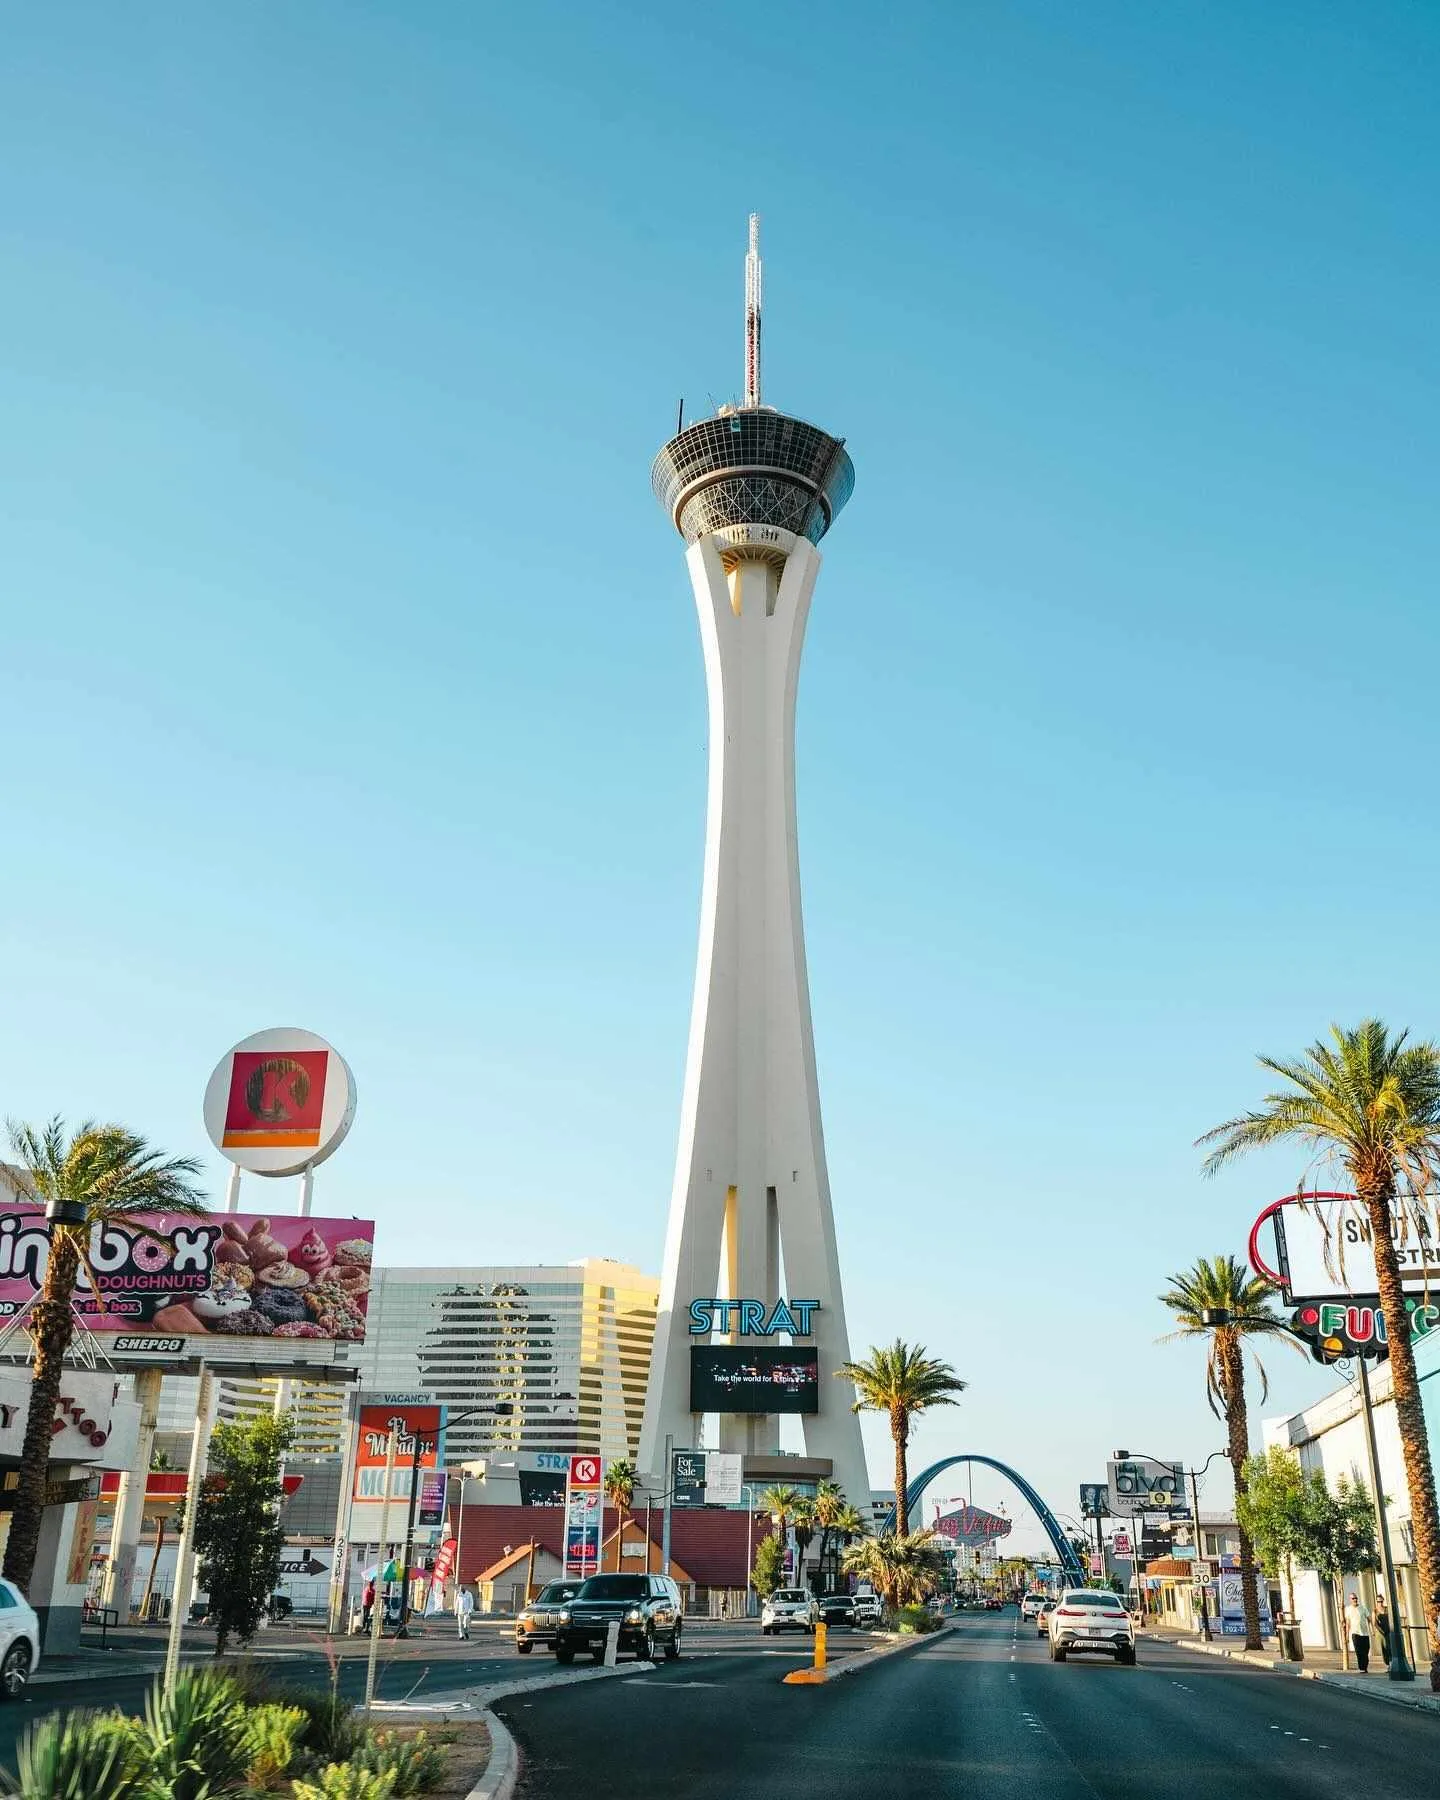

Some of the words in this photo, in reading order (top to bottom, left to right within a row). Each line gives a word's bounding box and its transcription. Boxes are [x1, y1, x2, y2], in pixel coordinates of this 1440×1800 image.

[97, 1274, 207, 1289] DOUGHNUTS
[689, 1297, 821, 1336] STRAT
[117, 1337, 182, 1351] SHEPCO
[714, 1374, 730, 1382] Take
[731, 1374, 742, 1382] the
[743, 1374, 761, 1382] world
[762, 1374, 772, 1382] for
[384, 1394, 431, 1403] VACANCY
[386, 1415, 409, 1436] El
[537, 1454, 570, 1468] STRA
[677, 1456, 693, 1467] For
[581, 1463, 594, 1478] K
[676, 1466, 697, 1476] Sale
[1114, 1465, 1178, 1493] blvd
[1194, 1574, 1210, 1584] 30
